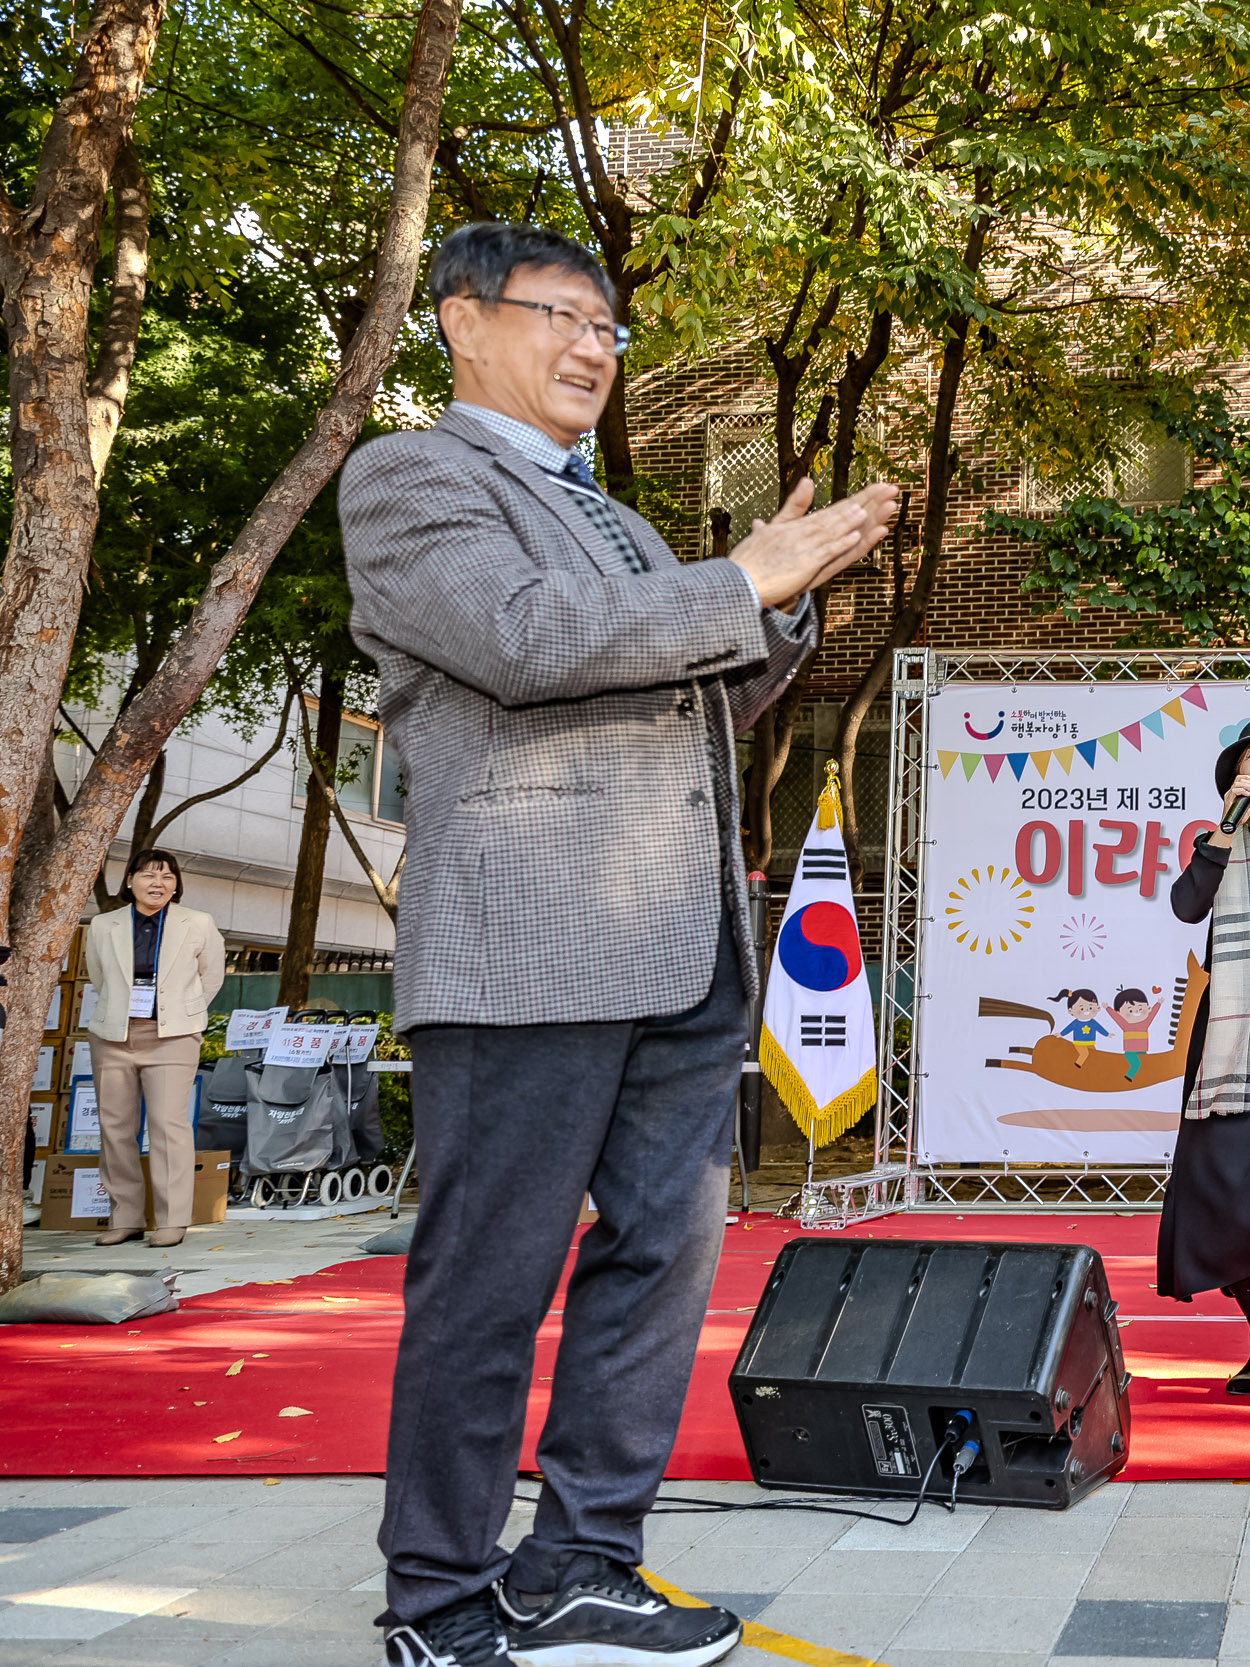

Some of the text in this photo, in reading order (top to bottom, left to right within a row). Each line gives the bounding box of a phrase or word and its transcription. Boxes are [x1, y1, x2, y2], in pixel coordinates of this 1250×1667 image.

[1011, 709, 1067, 722] 소통하며 발전하는
[1011, 721, 1079, 739] 행복자양1동
[1021, 786, 1186, 811] 2023년 제 3회
